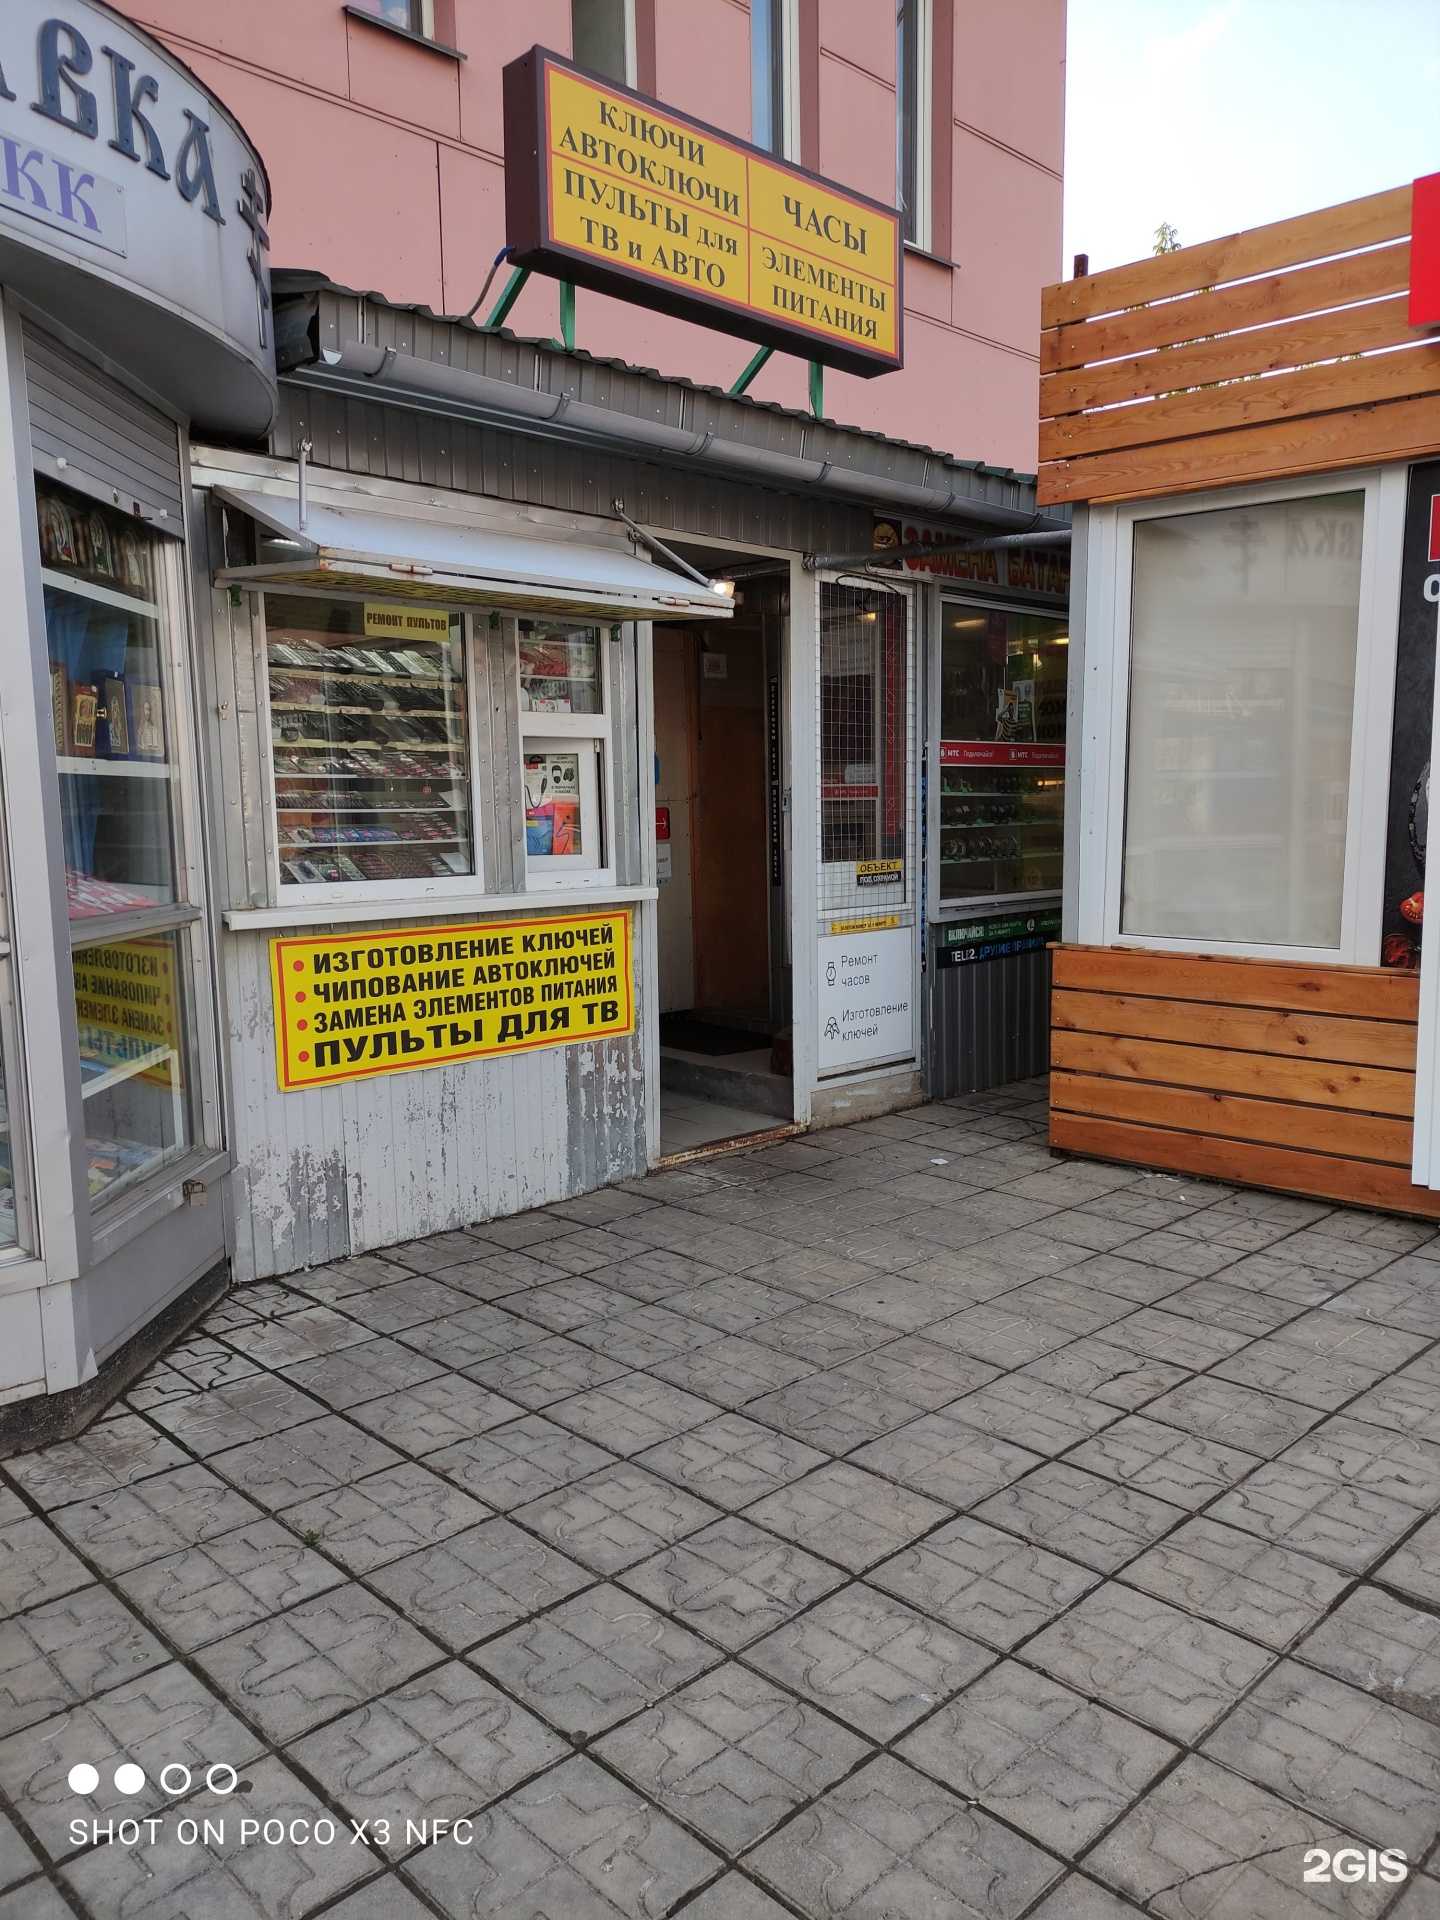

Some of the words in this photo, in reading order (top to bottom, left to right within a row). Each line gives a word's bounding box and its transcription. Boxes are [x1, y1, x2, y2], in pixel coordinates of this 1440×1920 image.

[0, 17, 227, 225] ВКА
[599, 101, 705, 167] КЛЮЧИ
[559, 126, 740, 217] АВТОКЛЮЧИ
[563, 168, 689, 238] ПУЛЬТЫ
[697, 226, 738, 256] для
[783, 194, 868, 256] ЧАСЫ
[580, 215, 619, 252] ТВ
[628, 240, 643, 261] и
[651, 249, 726, 289] АВТО
[761, 247, 887, 313] ЭЛЕМЕНТЫ
[772, 284, 878, 341] ПИТАНИЯ
[366, 612, 403, 628] РЕМОНТ
[406, 615, 447, 631] ПУЛЬТОВ
[860, 861, 898, 873] ОБЪЕКТ
[313, 936, 514, 975] ИЗГОТОВЛЕНИЕ
[522, 922, 614, 952] КЛЮЧЕЙ
[313, 970, 465, 1004] ЧИПОВАНИЕ
[472, 948, 615, 985] АВТОКЛЮЧЕЙ
[841, 953, 878, 968] Ремонт
[313, 1002, 406, 1034] ЗАМЕНА
[413, 987, 534, 1020] ЭЛЕМЕНТОВ
[541, 975, 618, 1002] ПИТАНИЯ
[841, 973, 870, 988] часов
[314, 1018, 484, 1068] ПУЛЬТЫ
[497, 1006, 571, 1043] ДЛЯ
[582, 999, 619, 1025] ТВ
[842, 1001, 909, 1023] Изготовление
[842, 1023, 879, 1042] ключей
